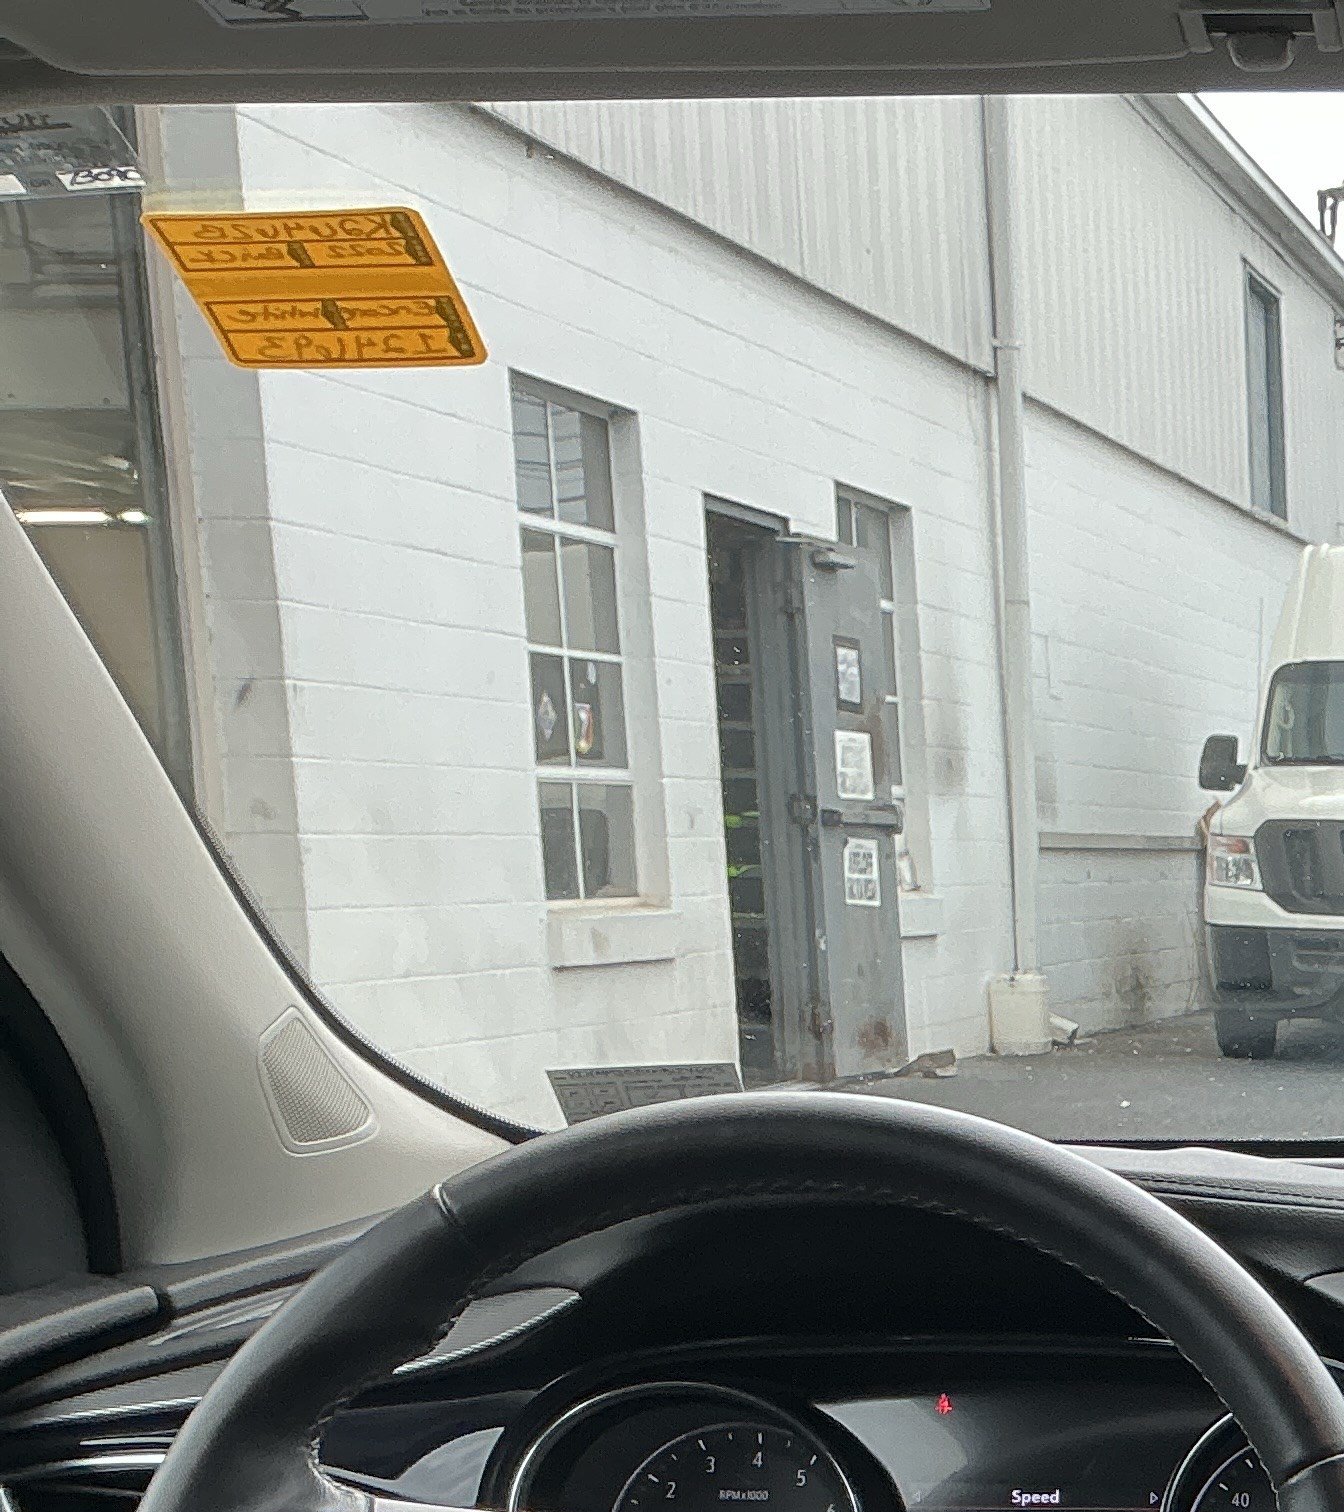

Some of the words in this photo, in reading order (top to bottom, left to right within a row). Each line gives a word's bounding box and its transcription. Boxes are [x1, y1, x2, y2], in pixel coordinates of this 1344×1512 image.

[706, 1455, 716, 1474] 3
[752, 1451, 763, 1468] 4
[796, 1469, 807, 1487] 5
[666, 1481, 677, 1499] 2
[1011, 1488, 1061, 1507] Speed
[1231, 1492, 1250, 1508] 40
